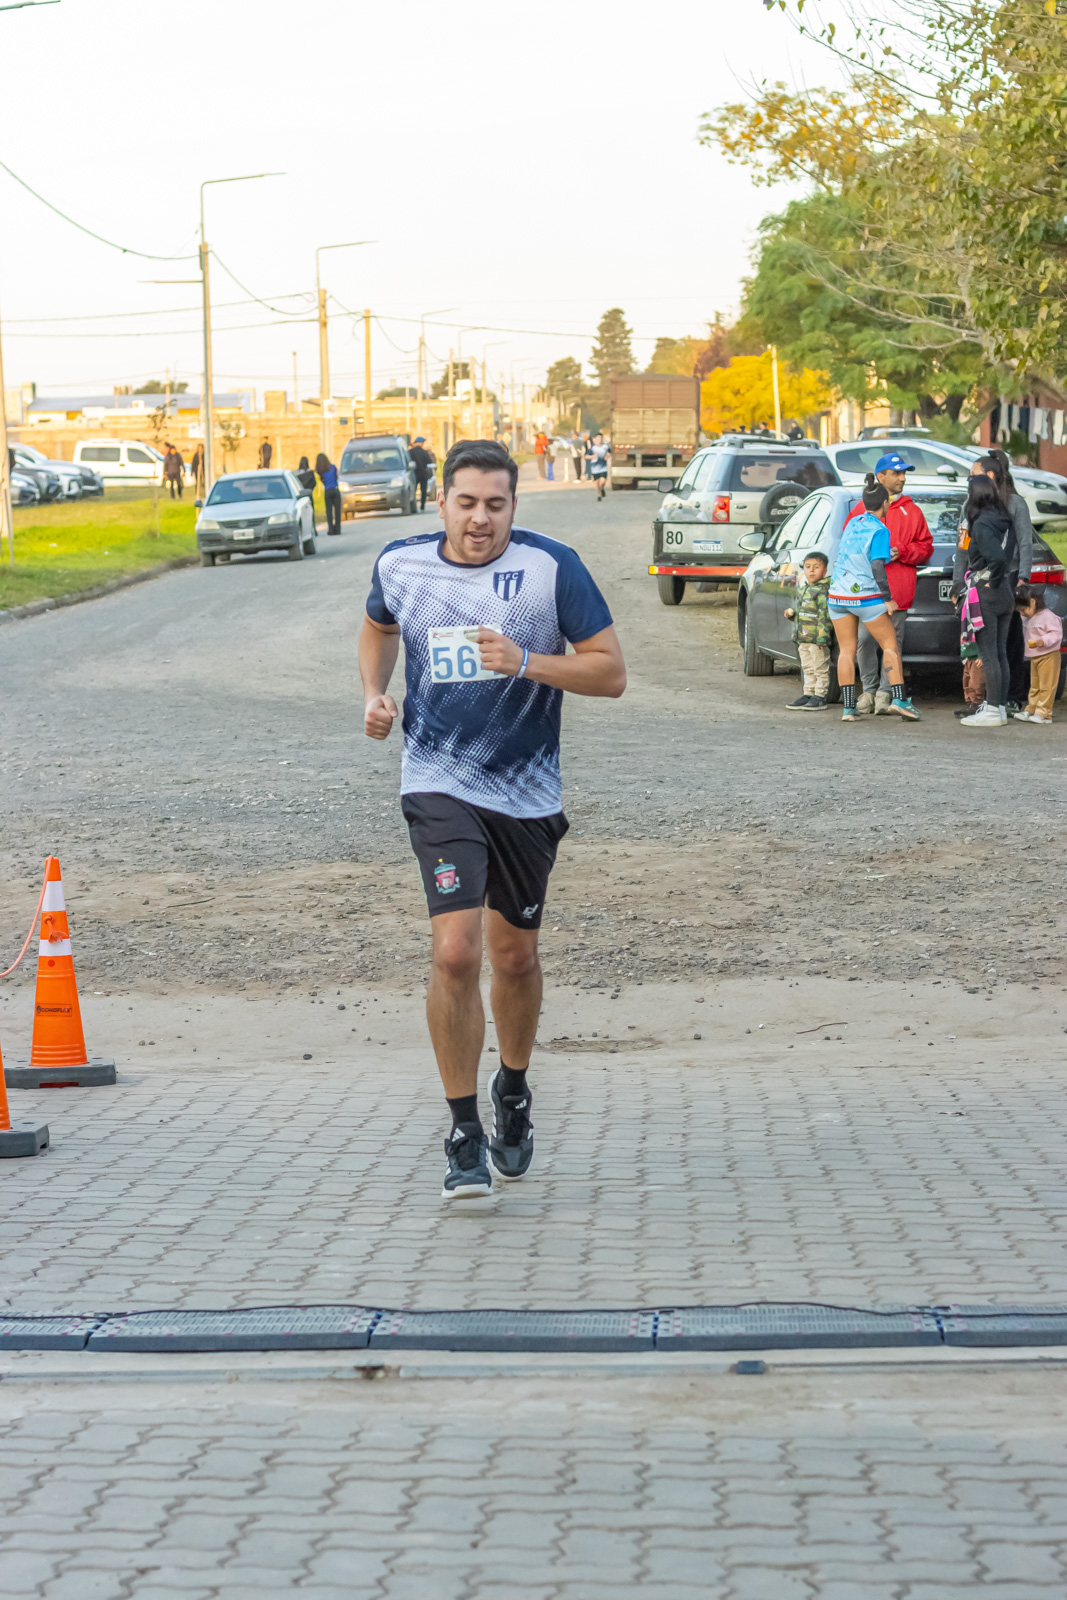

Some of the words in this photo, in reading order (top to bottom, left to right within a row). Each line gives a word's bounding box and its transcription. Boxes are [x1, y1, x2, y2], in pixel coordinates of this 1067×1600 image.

[666, 531, 683, 545] 80
[498, 572, 519, 581] SFC
[432, 645, 501, 679] 56
